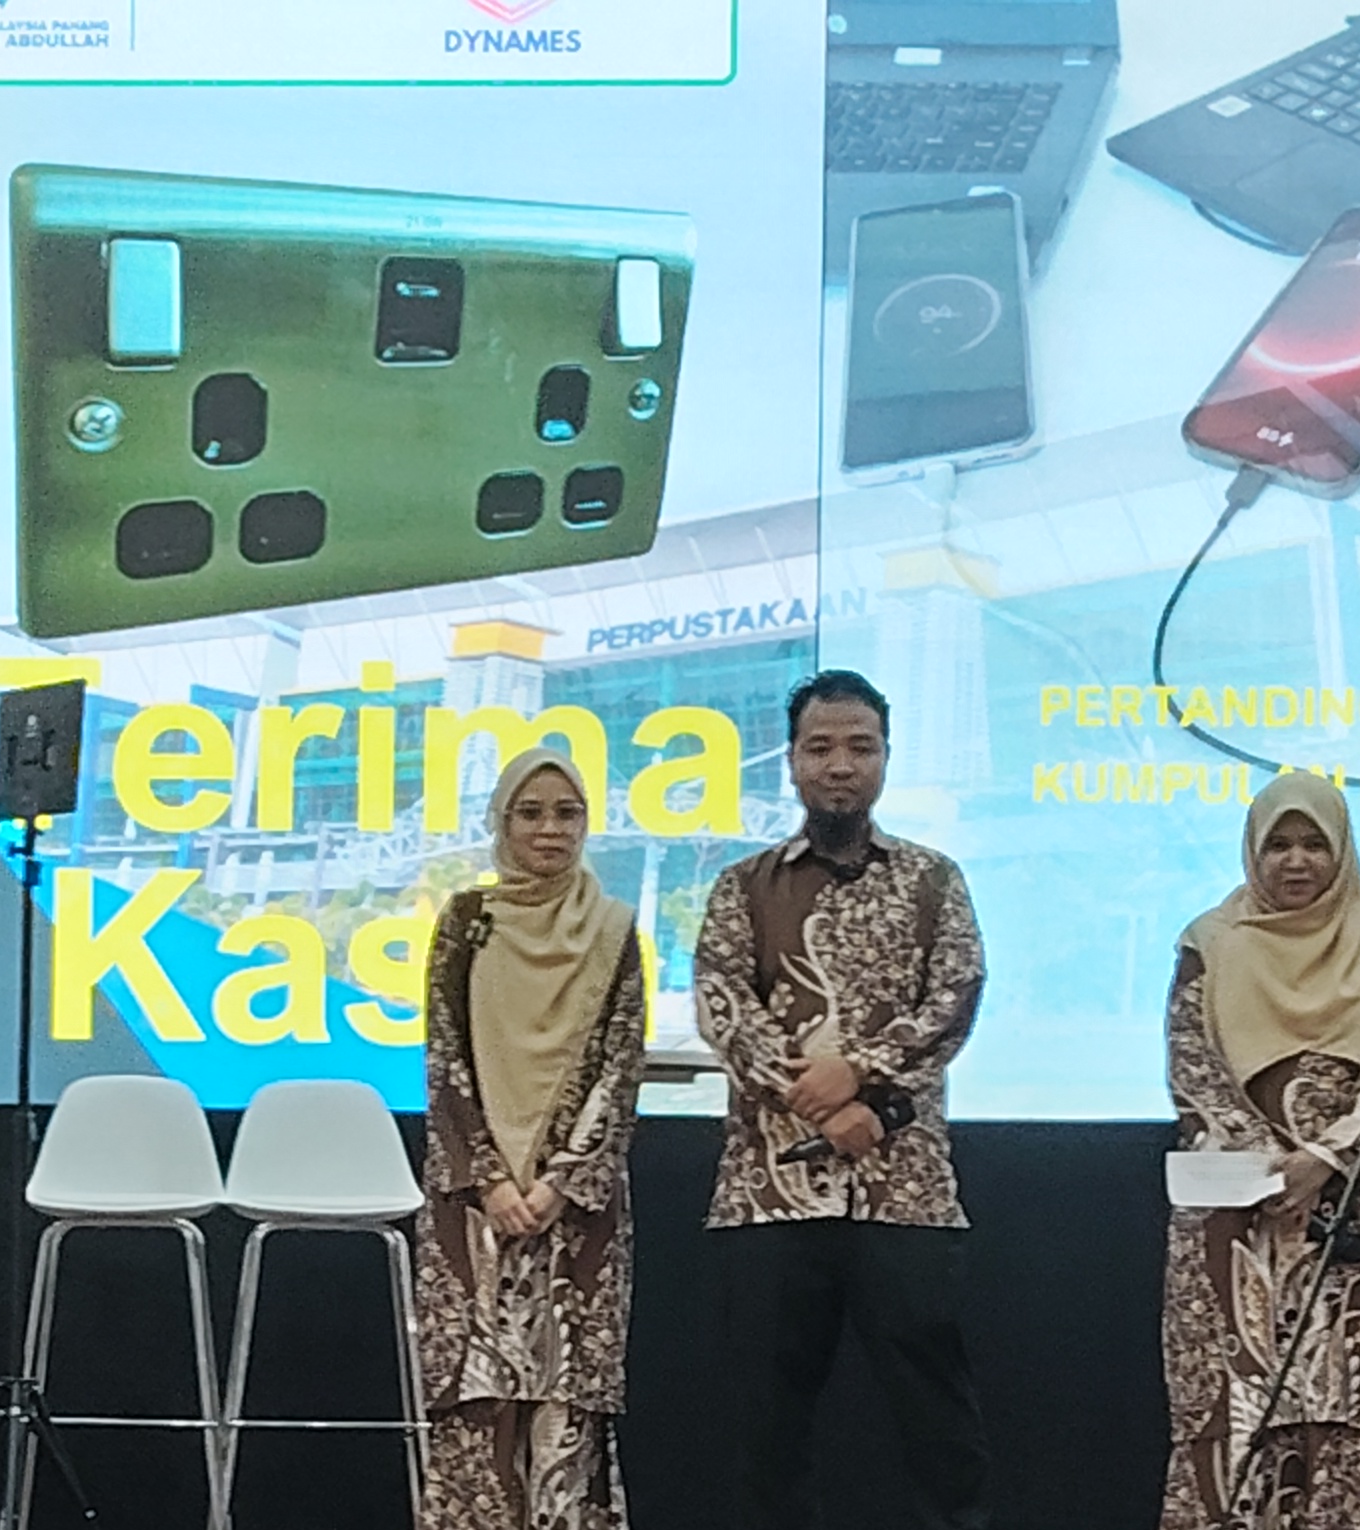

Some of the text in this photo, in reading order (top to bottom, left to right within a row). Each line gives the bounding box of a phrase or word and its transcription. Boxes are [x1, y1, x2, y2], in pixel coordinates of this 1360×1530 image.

[4, 34, 109, 47] ABDULLAH
[444, 29, 582, 52] DYNAMES
[587, 587, 866, 653] PERPUSTAKAAN
[1032, 762, 1345, 804] KUMPUL
[50, 867, 658, 1045] Kas
